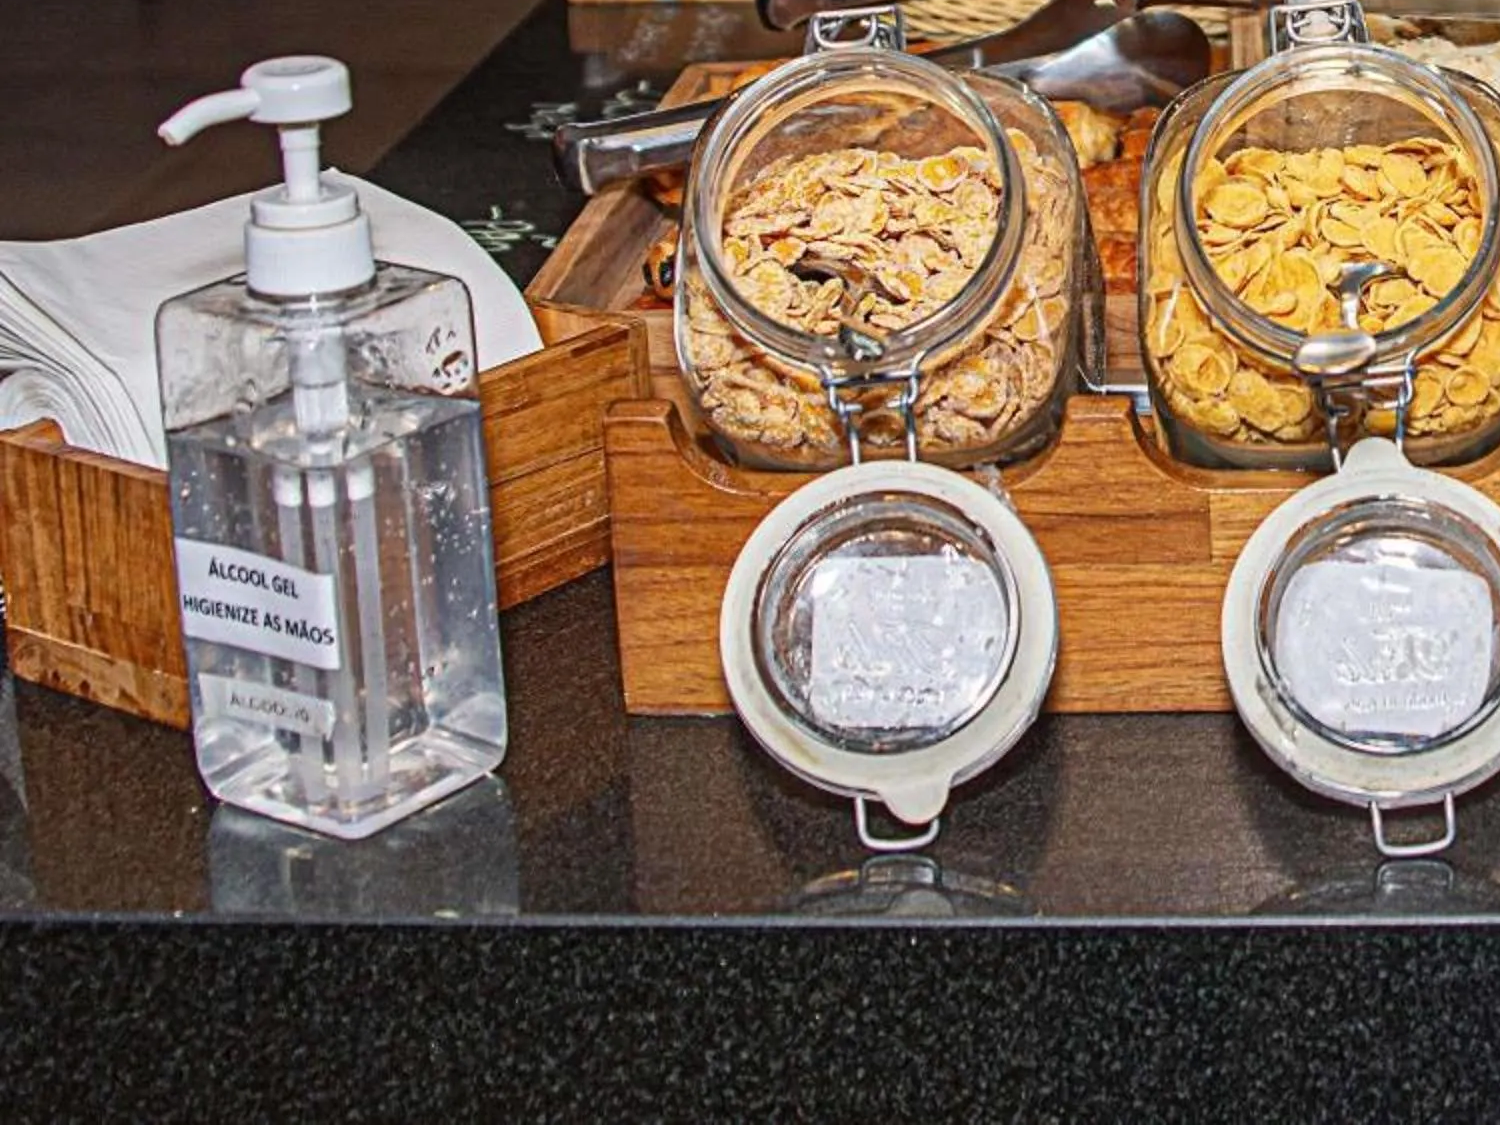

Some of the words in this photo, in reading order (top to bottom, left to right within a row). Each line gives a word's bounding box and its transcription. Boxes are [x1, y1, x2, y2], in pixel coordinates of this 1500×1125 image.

[208, 556, 270, 590] ÁLCOOL
[271, 574, 299, 600] GEL
[183, 594, 259, 626] HIGIENIZE
[263, 612, 281, 633] AS
[285, 617, 335, 645] MÃOS
